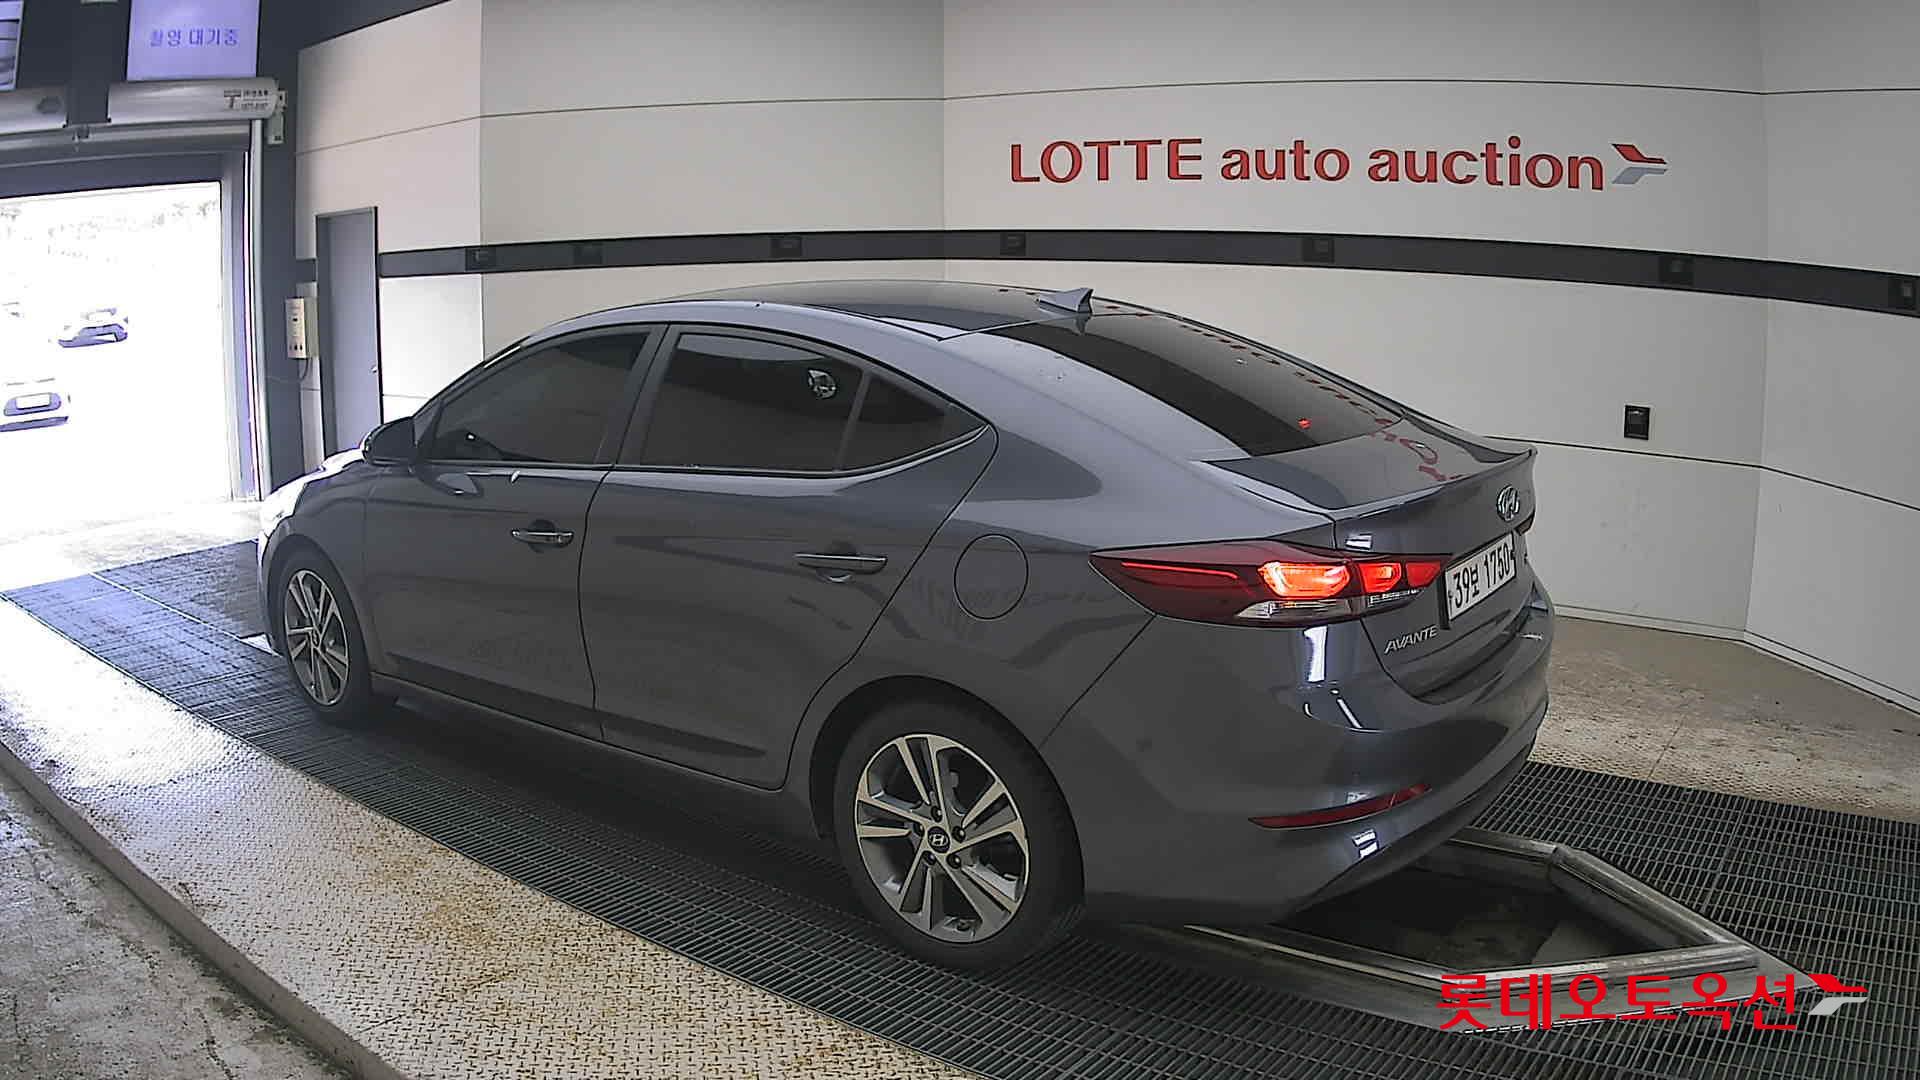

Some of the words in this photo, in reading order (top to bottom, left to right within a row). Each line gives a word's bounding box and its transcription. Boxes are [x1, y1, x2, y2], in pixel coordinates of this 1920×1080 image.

[1010, 138, 1203, 183] LOTTE
[1221, 139, 1350, 181] auto
[1367, 135, 1605, 191] auction
[1453, 563, 1480, 608] 39보
[1484, 542, 1510, 589] 1750
[1384, 624, 1438, 655] AVANTE
